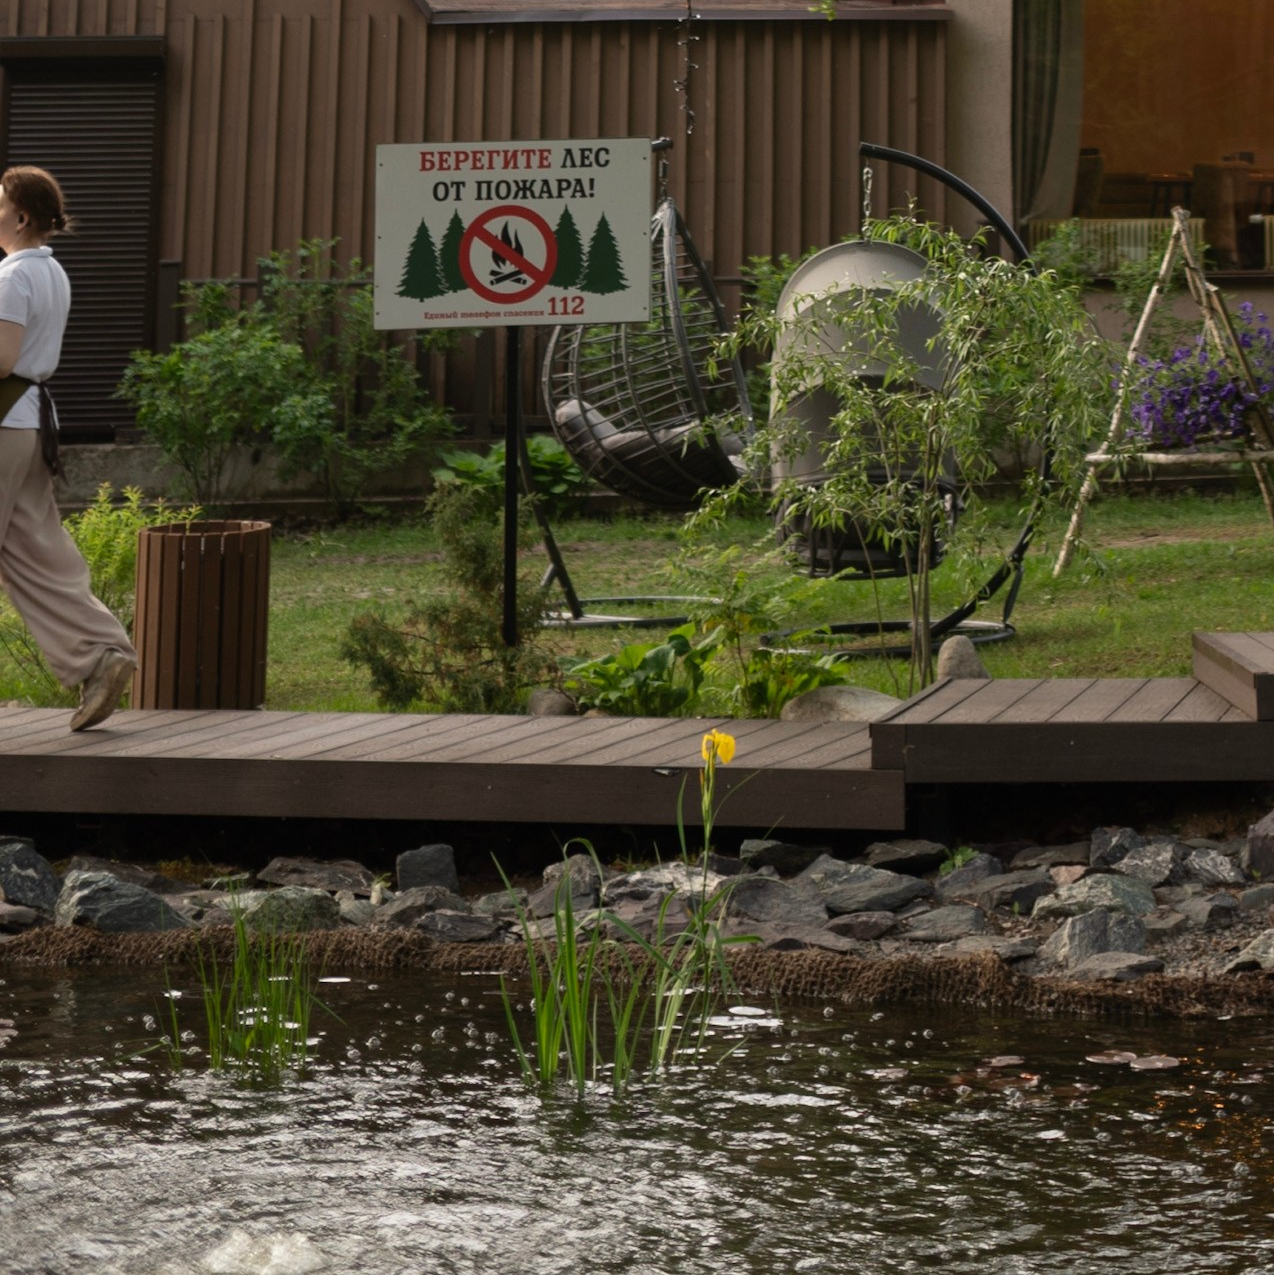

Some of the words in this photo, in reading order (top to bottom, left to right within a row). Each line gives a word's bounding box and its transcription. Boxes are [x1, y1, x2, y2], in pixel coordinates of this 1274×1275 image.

[419, 149, 552, 172] БЕРЕГИТЕ
[560, 147, 610, 168] ЛЕС
[433, 181, 466, 201] ОТ
[474, 178, 595, 201] ПОЖАРА!
[424, 310, 458, 320] Единый
[460, 310, 501, 320] телефон
[503, 309, 545, 318] спасения
[548, 296, 585, 316] 112
